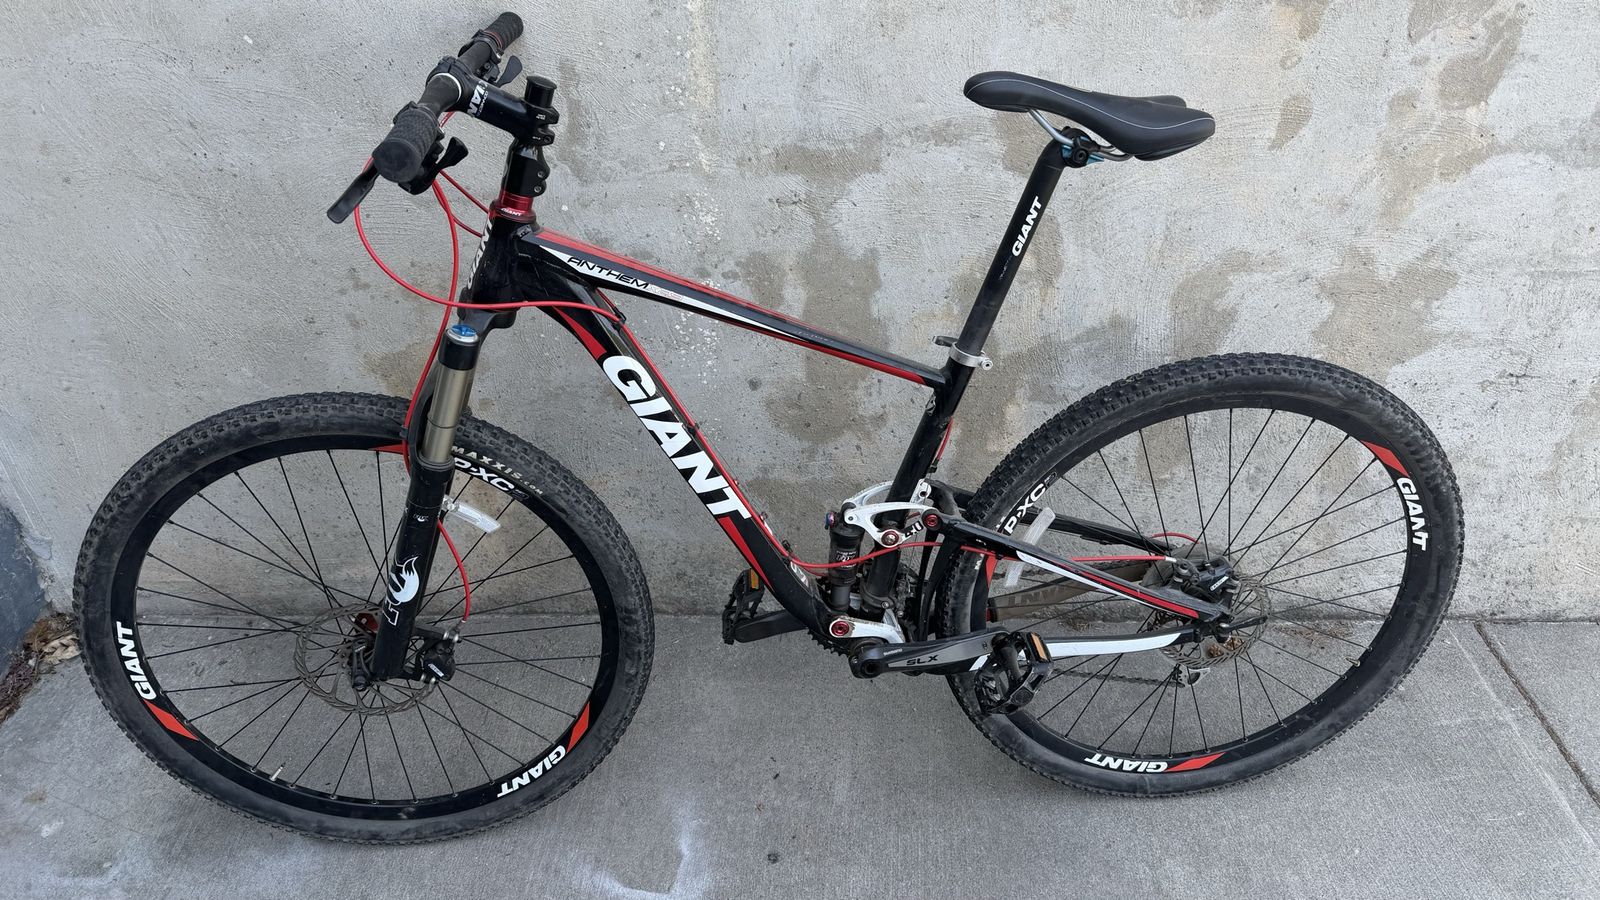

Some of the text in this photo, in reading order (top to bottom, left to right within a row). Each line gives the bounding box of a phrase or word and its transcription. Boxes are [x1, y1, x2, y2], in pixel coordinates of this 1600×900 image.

[501, 207, 522, 217] GIANT
[1012, 196, 1041, 256] GIANT
[467, 219, 493, 290] GIANT
[567, 257, 649, 289] ANTHEM
[603, 355, 751, 519] GIANT
[1397, 477, 1429, 551] GIANT
[116, 621, 157, 700] GIANT
[906, 654, 938, 666] SLX
[497, 745, 566, 797] GIANT
[1084, 753, 1168, 773] GIANT
